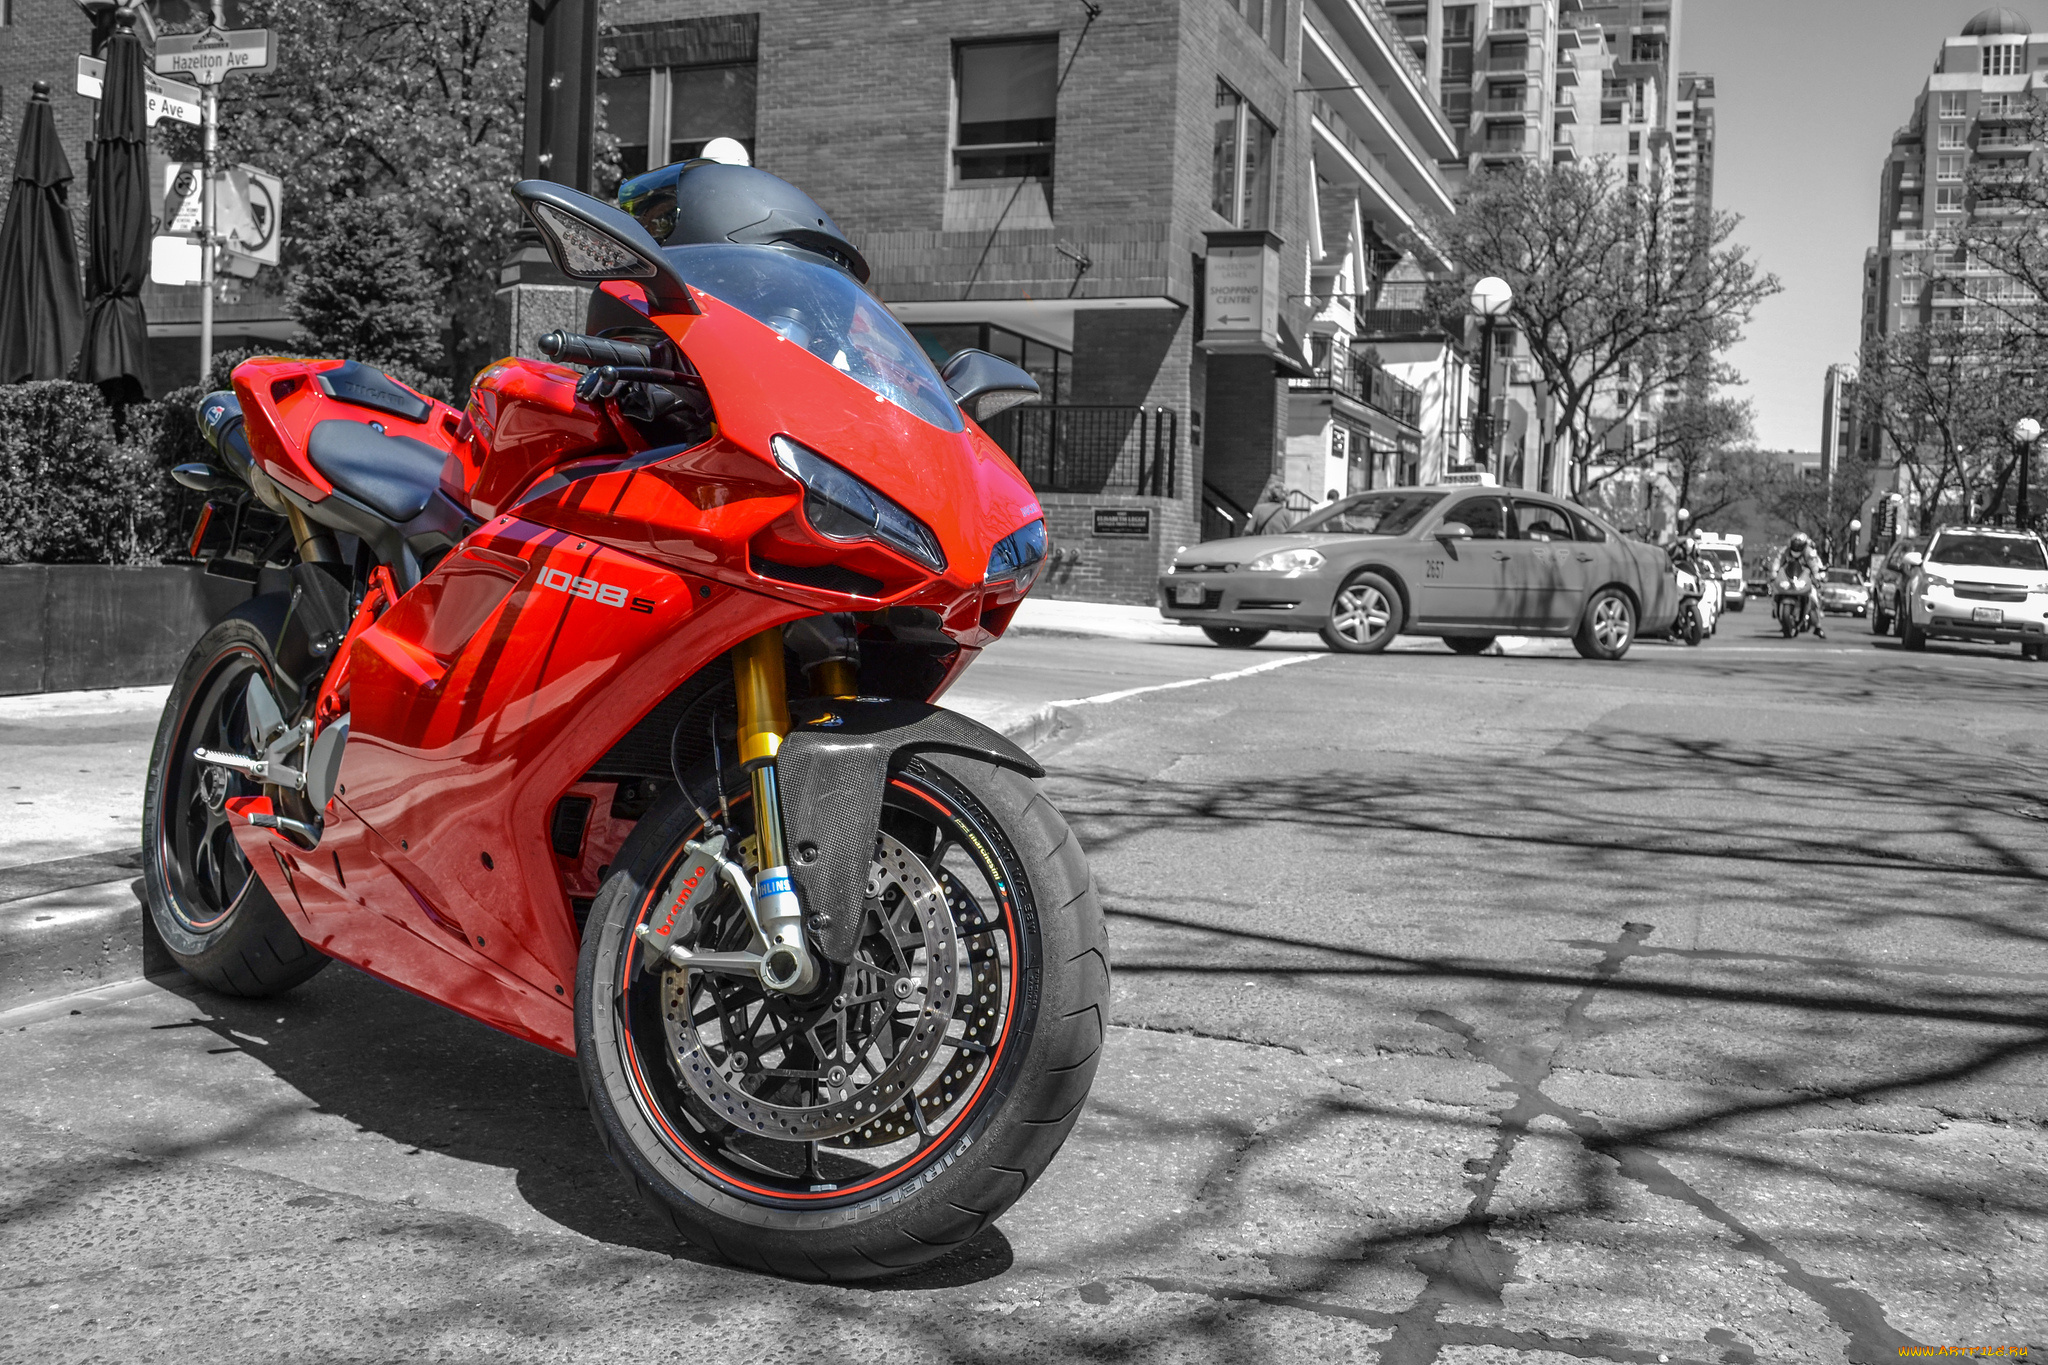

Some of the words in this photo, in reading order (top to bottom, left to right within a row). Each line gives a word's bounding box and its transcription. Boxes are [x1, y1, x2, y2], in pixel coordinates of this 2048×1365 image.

[172, 54, 223, 70] Hazelton
[226, 51, 249, 66] Ave
[161, 99, 184, 118] Ave
[1210, 285, 1259, 295] SHOPPING
[1216, 295, 1252, 305] CENTRE
[535, 565, 629, 608] 1098
[630, 597, 656, 614] S
[655, 866, 706, 937] brembo
[846, 1134, 975, 1221] PIRELLI
